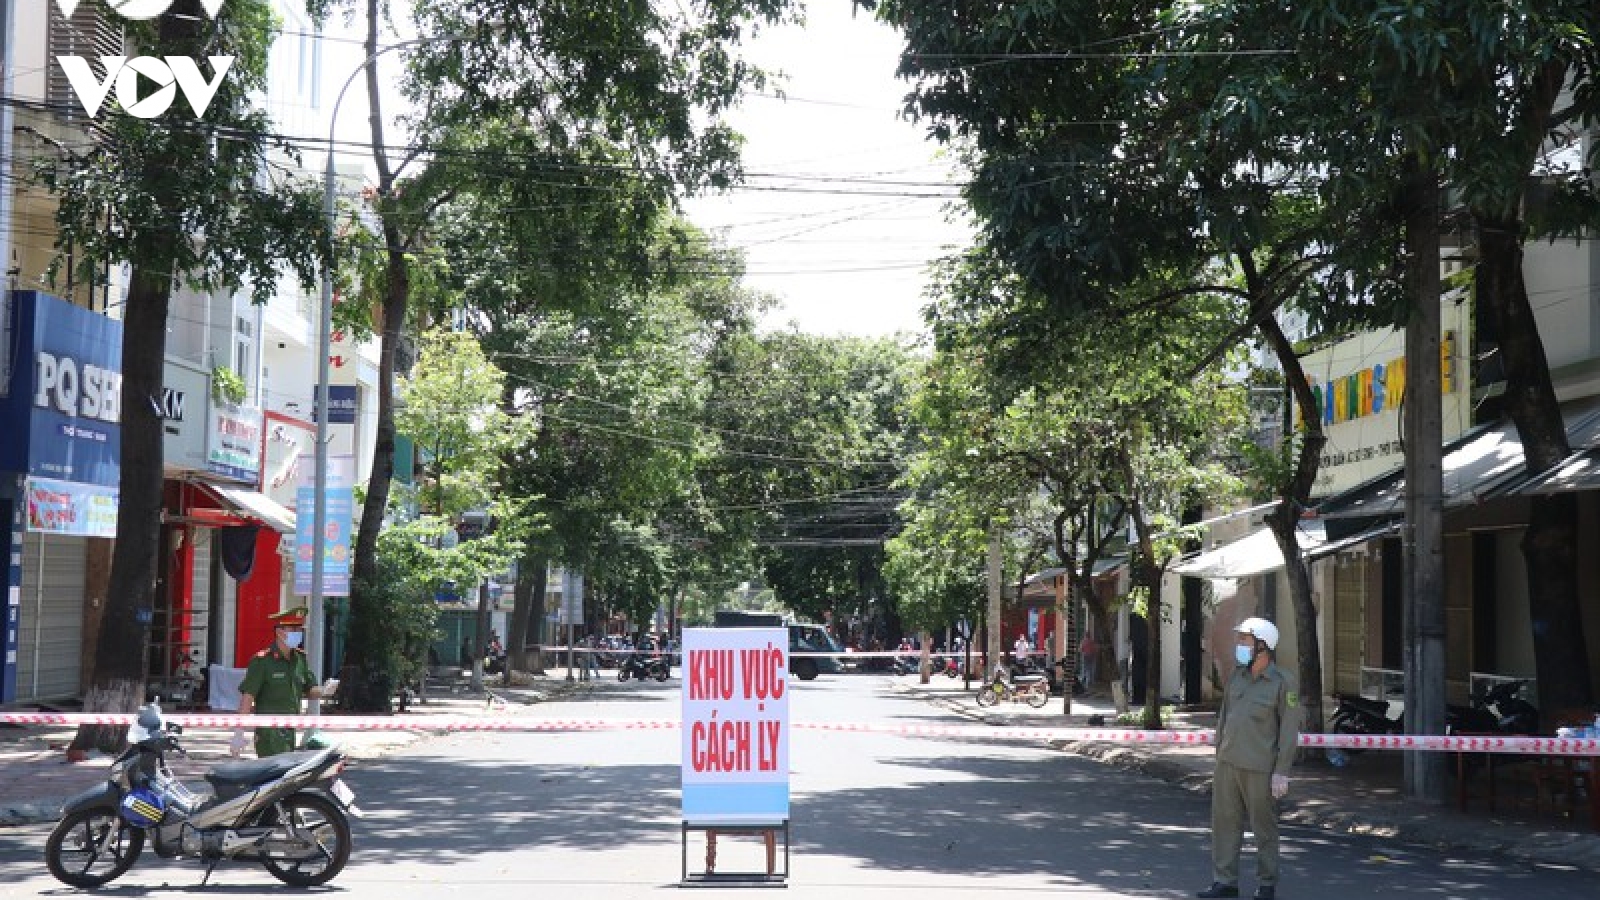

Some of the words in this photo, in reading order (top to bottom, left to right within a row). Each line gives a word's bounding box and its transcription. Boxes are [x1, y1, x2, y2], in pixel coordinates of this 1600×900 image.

[34, 351, 77, 416] PQ
[689, 649, 734, 700] KHU
[740, 641, 784, 711] VỰC
[691, 709, 751, 772] CÁCH
[757, 719, 781, 772] LY
